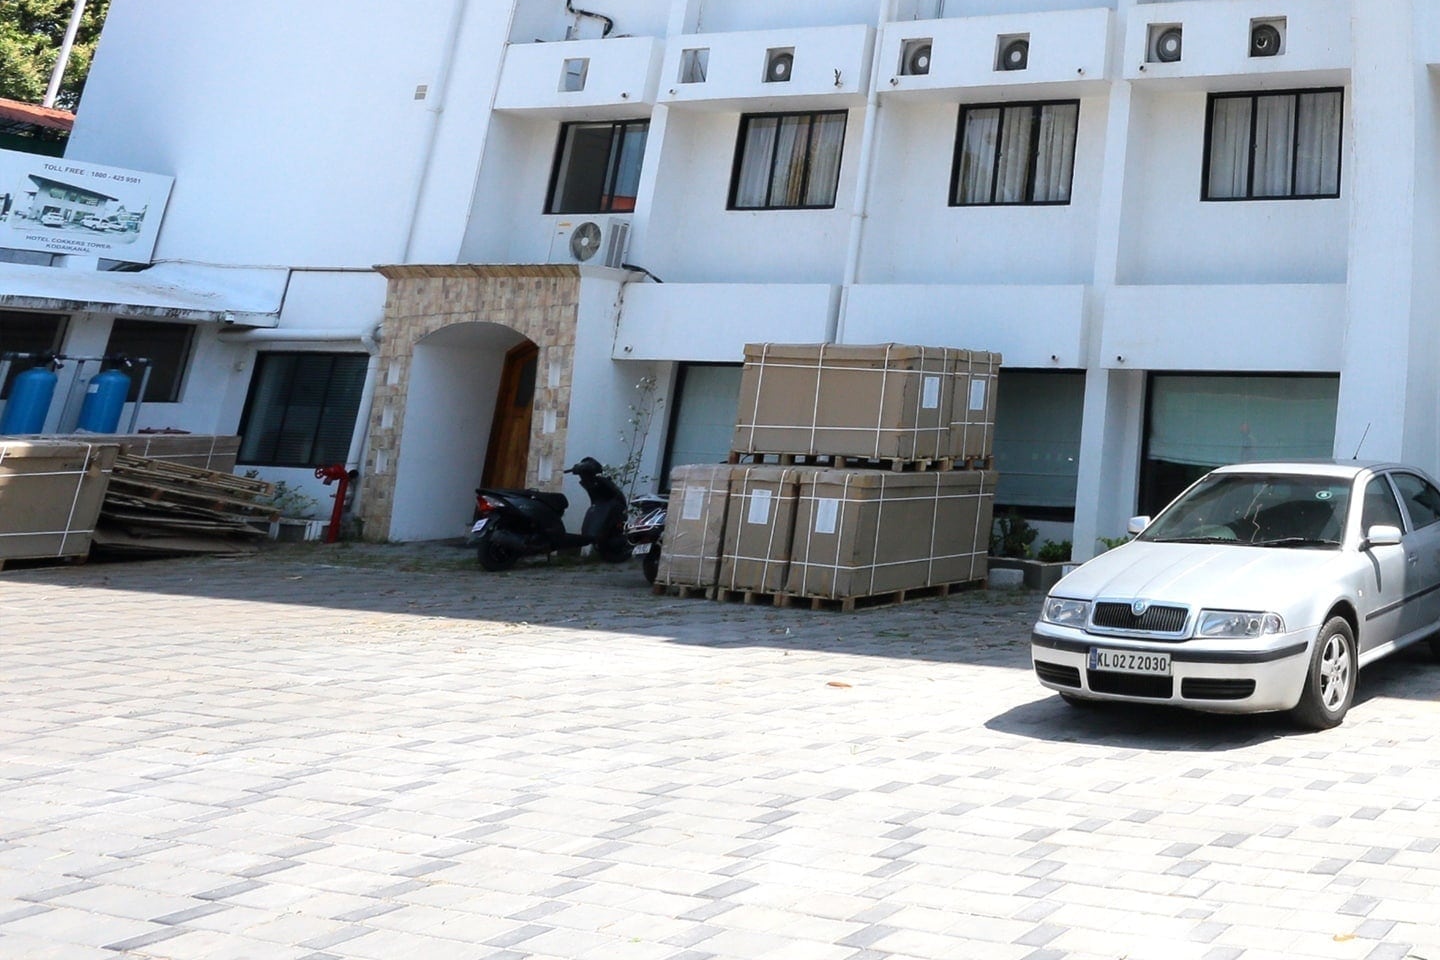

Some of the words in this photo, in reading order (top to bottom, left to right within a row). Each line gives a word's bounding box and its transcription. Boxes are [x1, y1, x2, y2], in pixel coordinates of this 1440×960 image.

[44, 163, 63, 172] TOLL
[65, 166, 86, 176] FREE
[26, 235, 50, 243] HOTEL
[1097, 652, 1110, 667] KL
[1113, 654, 1126, 669] 02
[1128, 655, 1136, 669] Z
[1137, 656, 1166, 671] 2030
